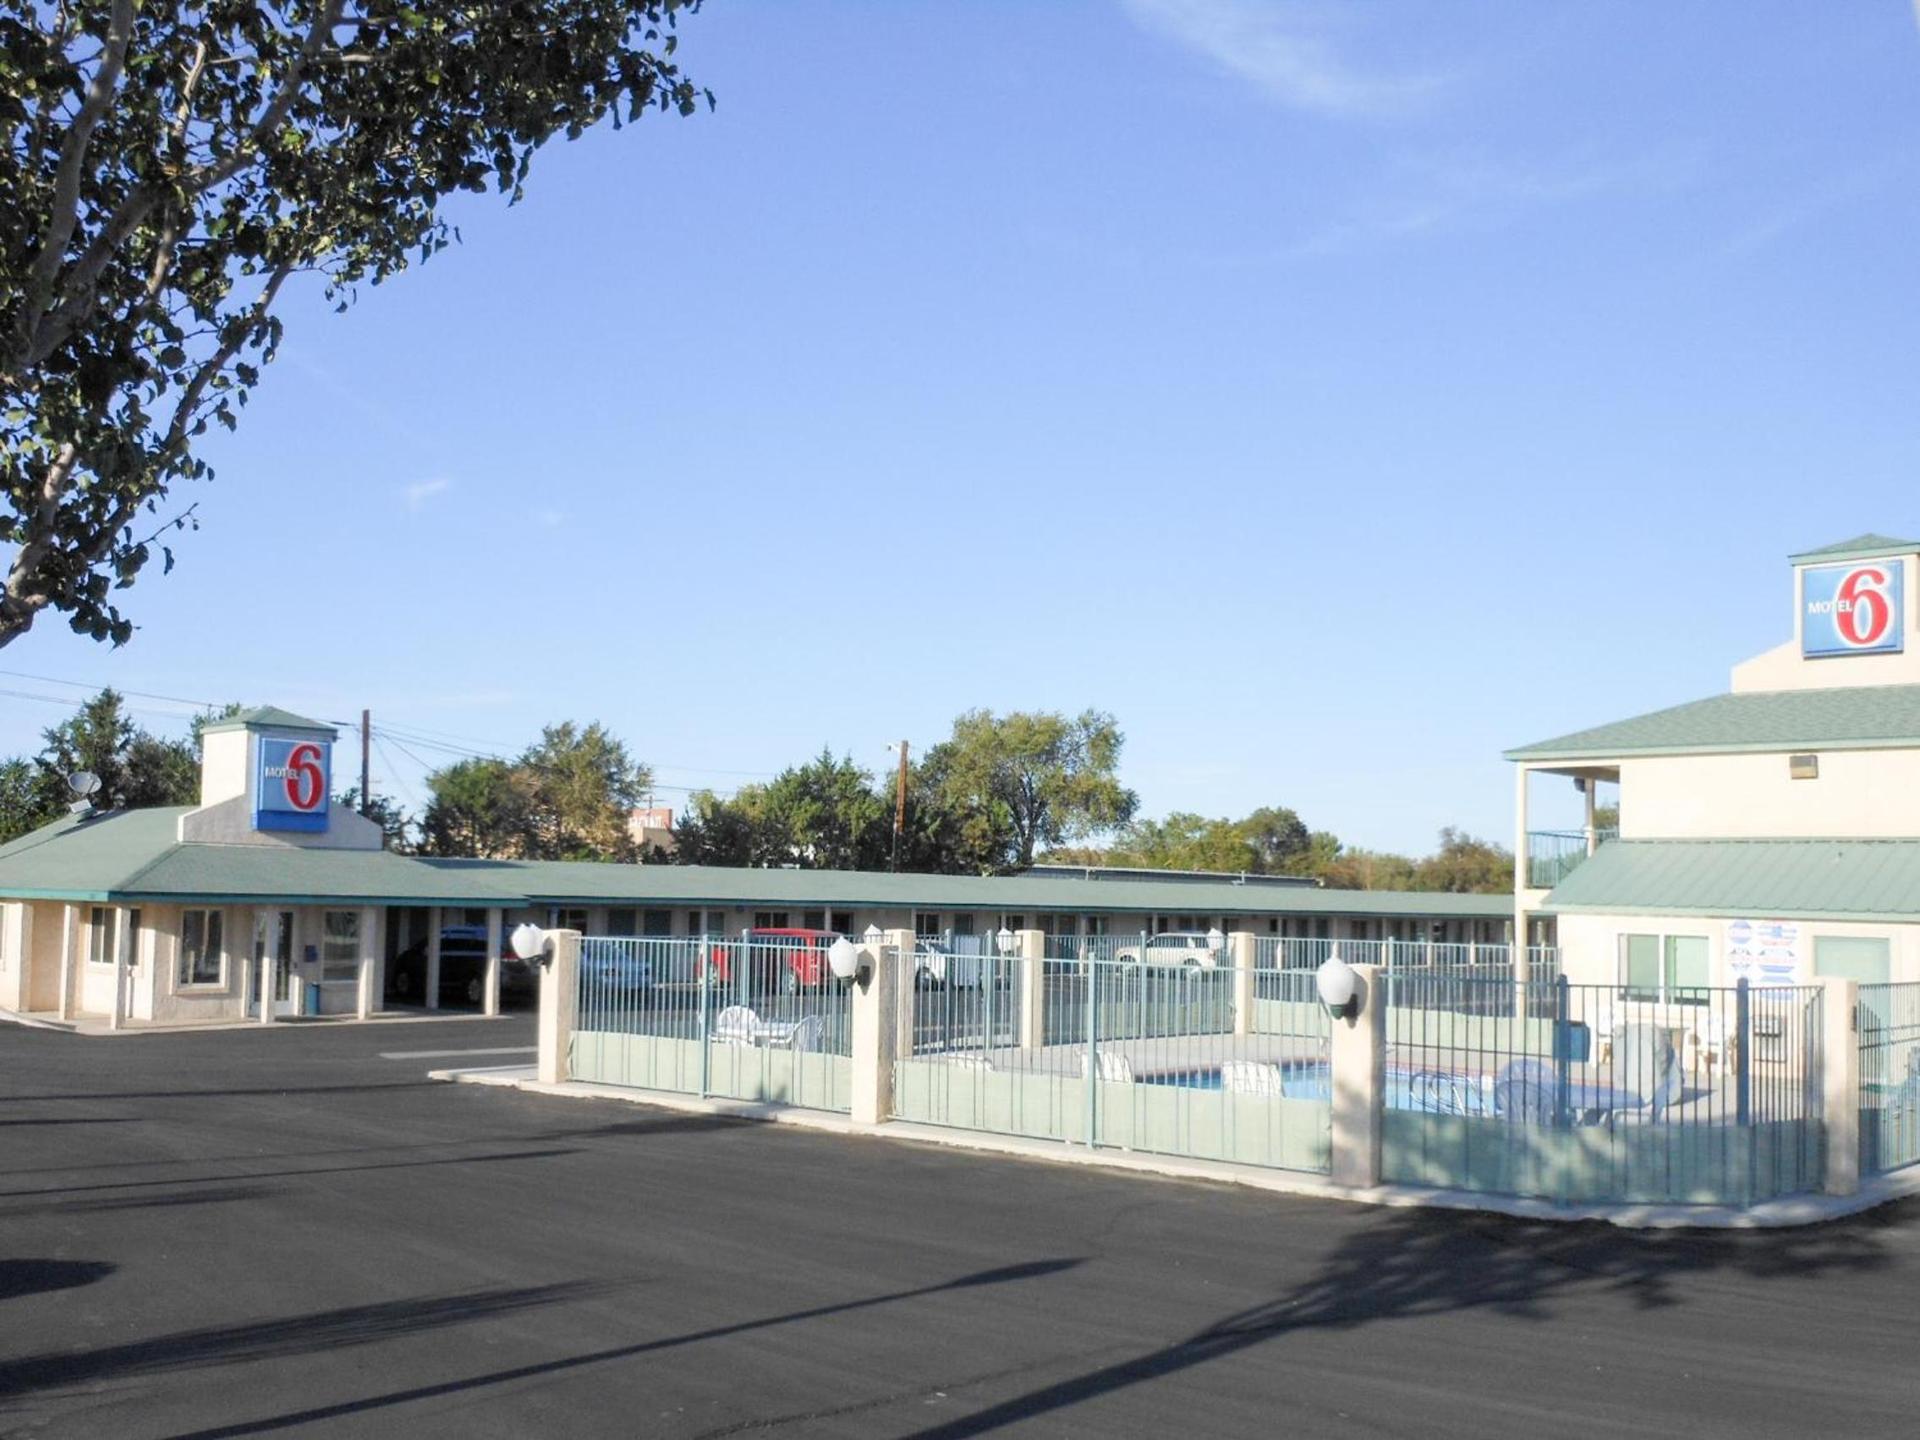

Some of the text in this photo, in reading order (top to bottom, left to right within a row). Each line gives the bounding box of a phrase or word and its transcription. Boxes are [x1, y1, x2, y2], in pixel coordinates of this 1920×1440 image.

[1807, 567, 1890, 646] MOTEL 6
[264, 743, 325, 811] MOTEL 6
